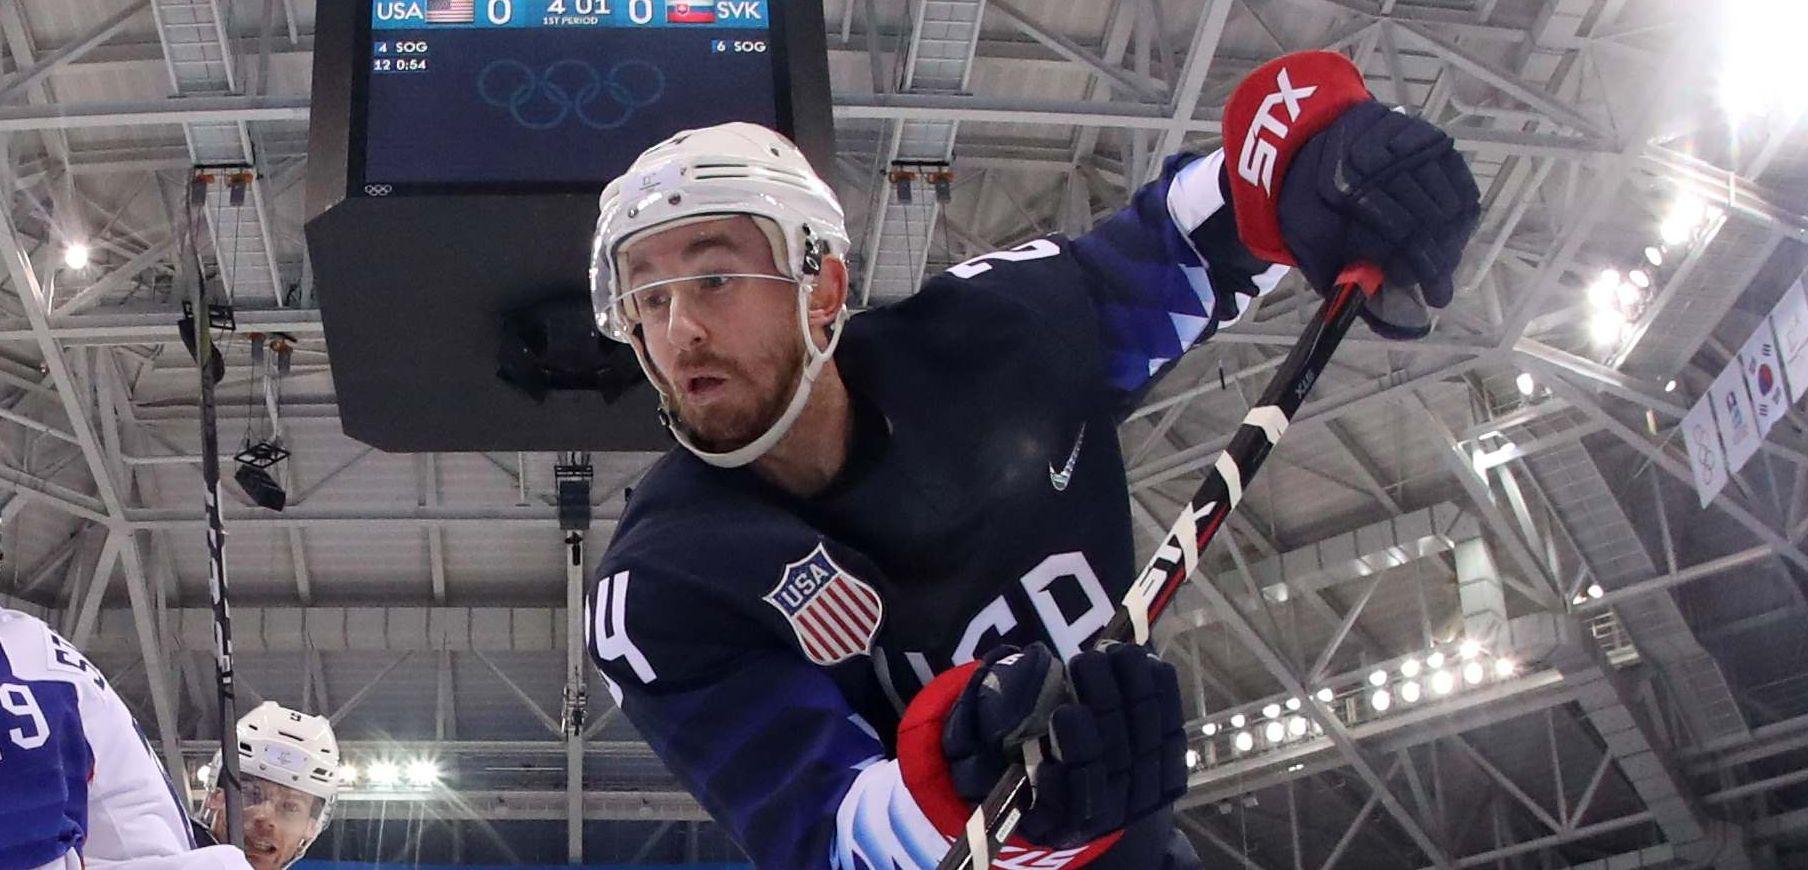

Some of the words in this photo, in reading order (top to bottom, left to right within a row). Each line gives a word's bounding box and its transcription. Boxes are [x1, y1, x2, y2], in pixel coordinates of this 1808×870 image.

[377, 1, 424, 20] USA
[487, 0, 511, 25] 0
[547, 0, 566, 14] 4
[628, 0, 652, 25] 0
[716, 1, 761, 19] SVK
[543, 16, 559, 25] 1ST
[561, 16, 599, 25] PERIOD
[378, 42, 387, 53] 4
[395, 41, 428, 53] SOG
[716, 40, 726, 52] 6
[733, 41, 766, 52] SOG
[373, 59, 391, 71] 12
[396, 59, 427, 71] 0:54
[1238, 66, 1318, 198] STX
[780, 561, 831, 609] USA
[584, 570, 658, 709] 4
[0, 682, 51, 750] 9
